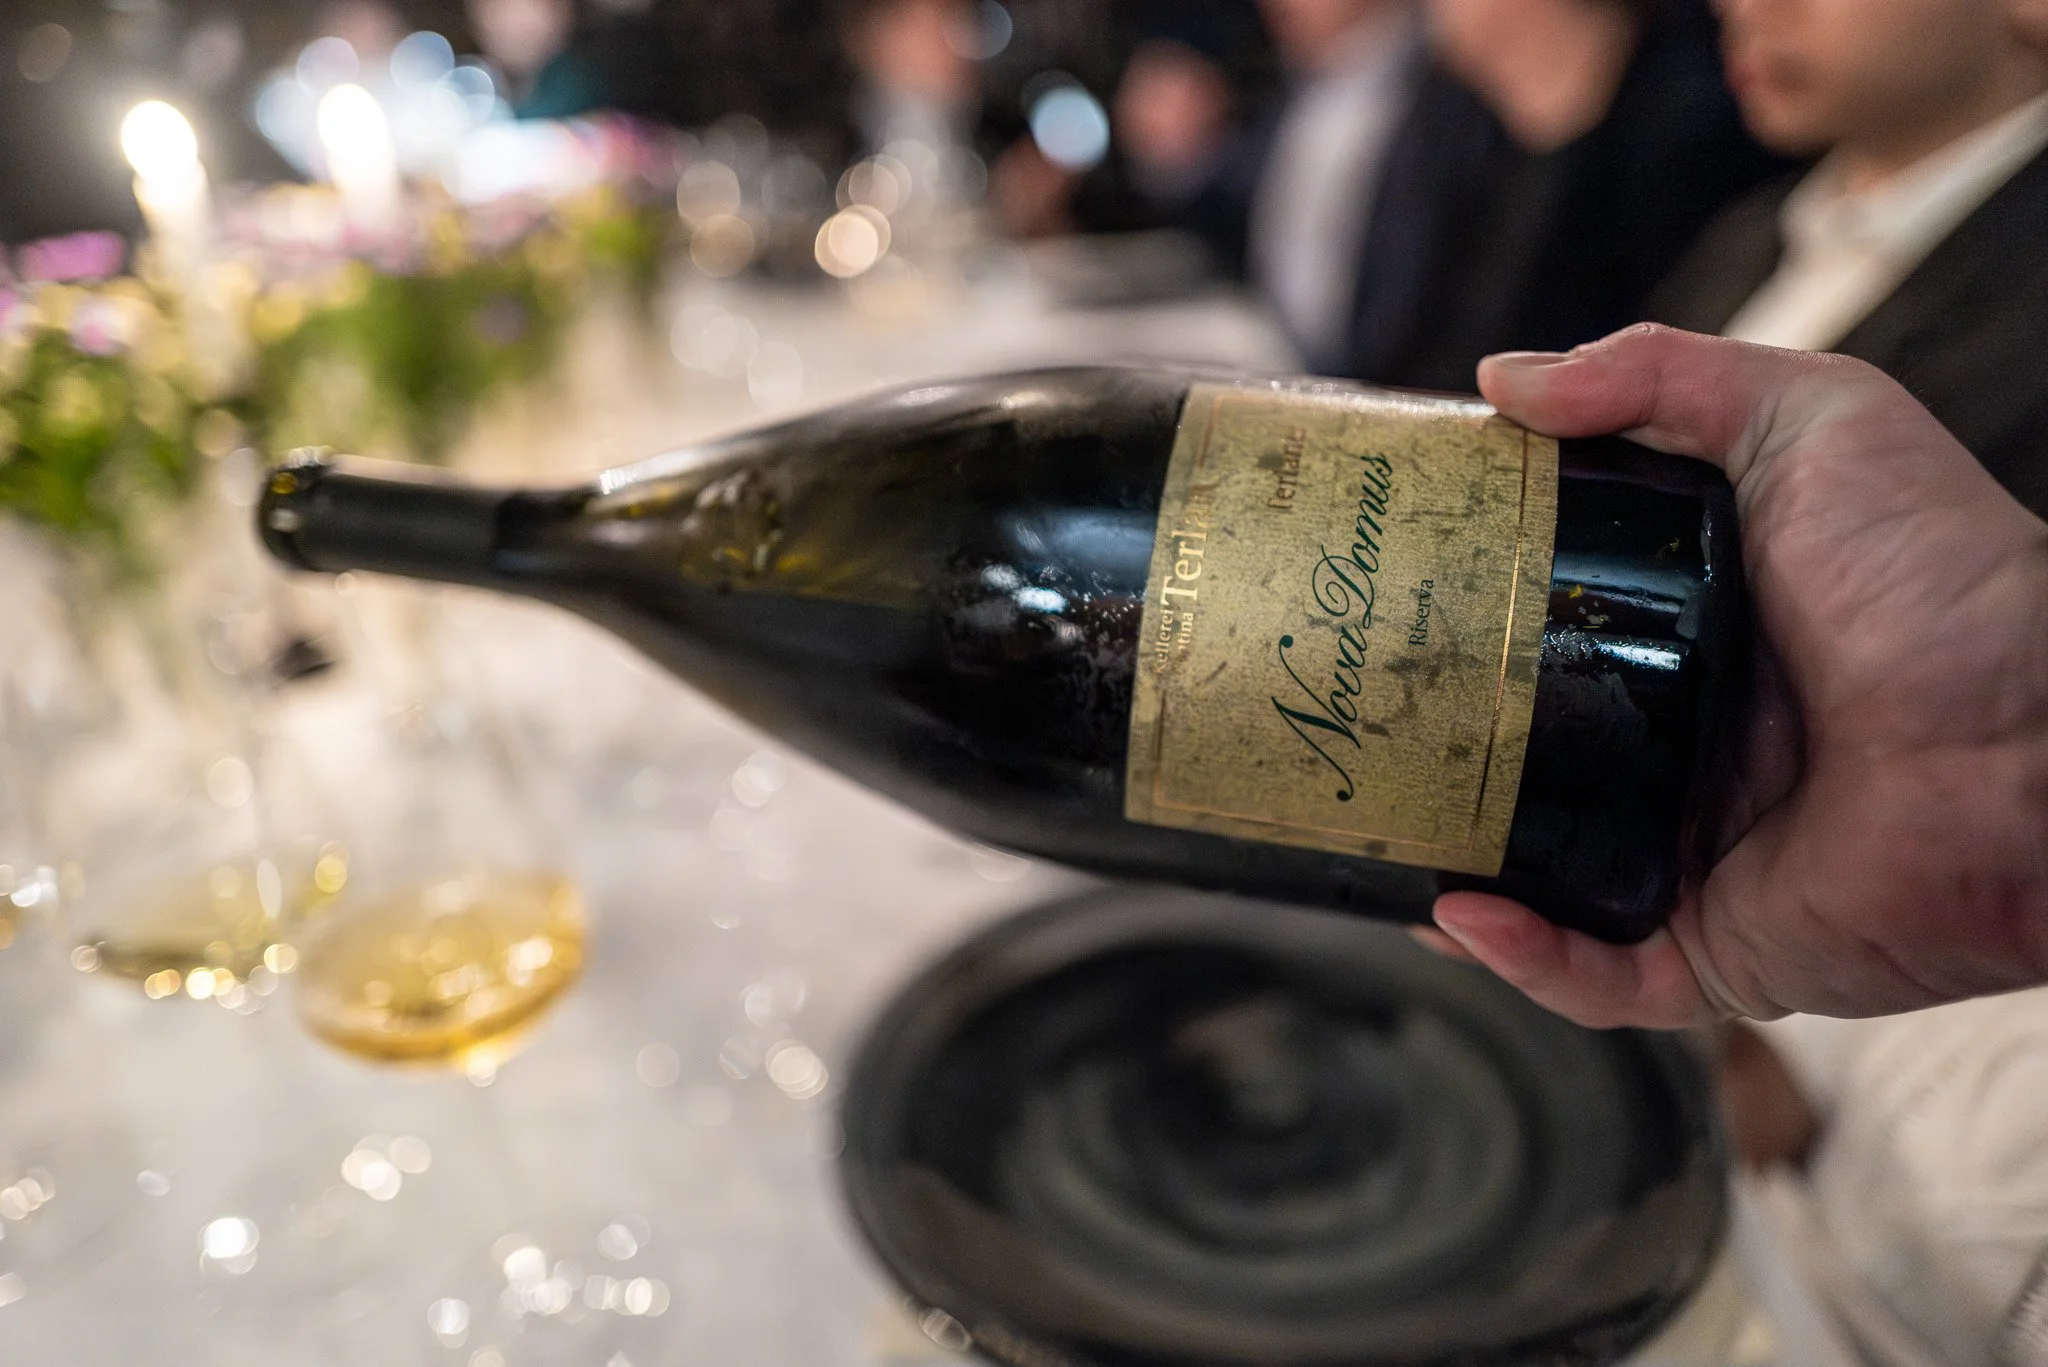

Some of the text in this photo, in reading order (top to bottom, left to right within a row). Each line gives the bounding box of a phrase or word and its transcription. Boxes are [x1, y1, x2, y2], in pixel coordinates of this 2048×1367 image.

[1271, 452, 1395, 802] Nova Domus
[1408, 578, 1435, 647] Riserva
